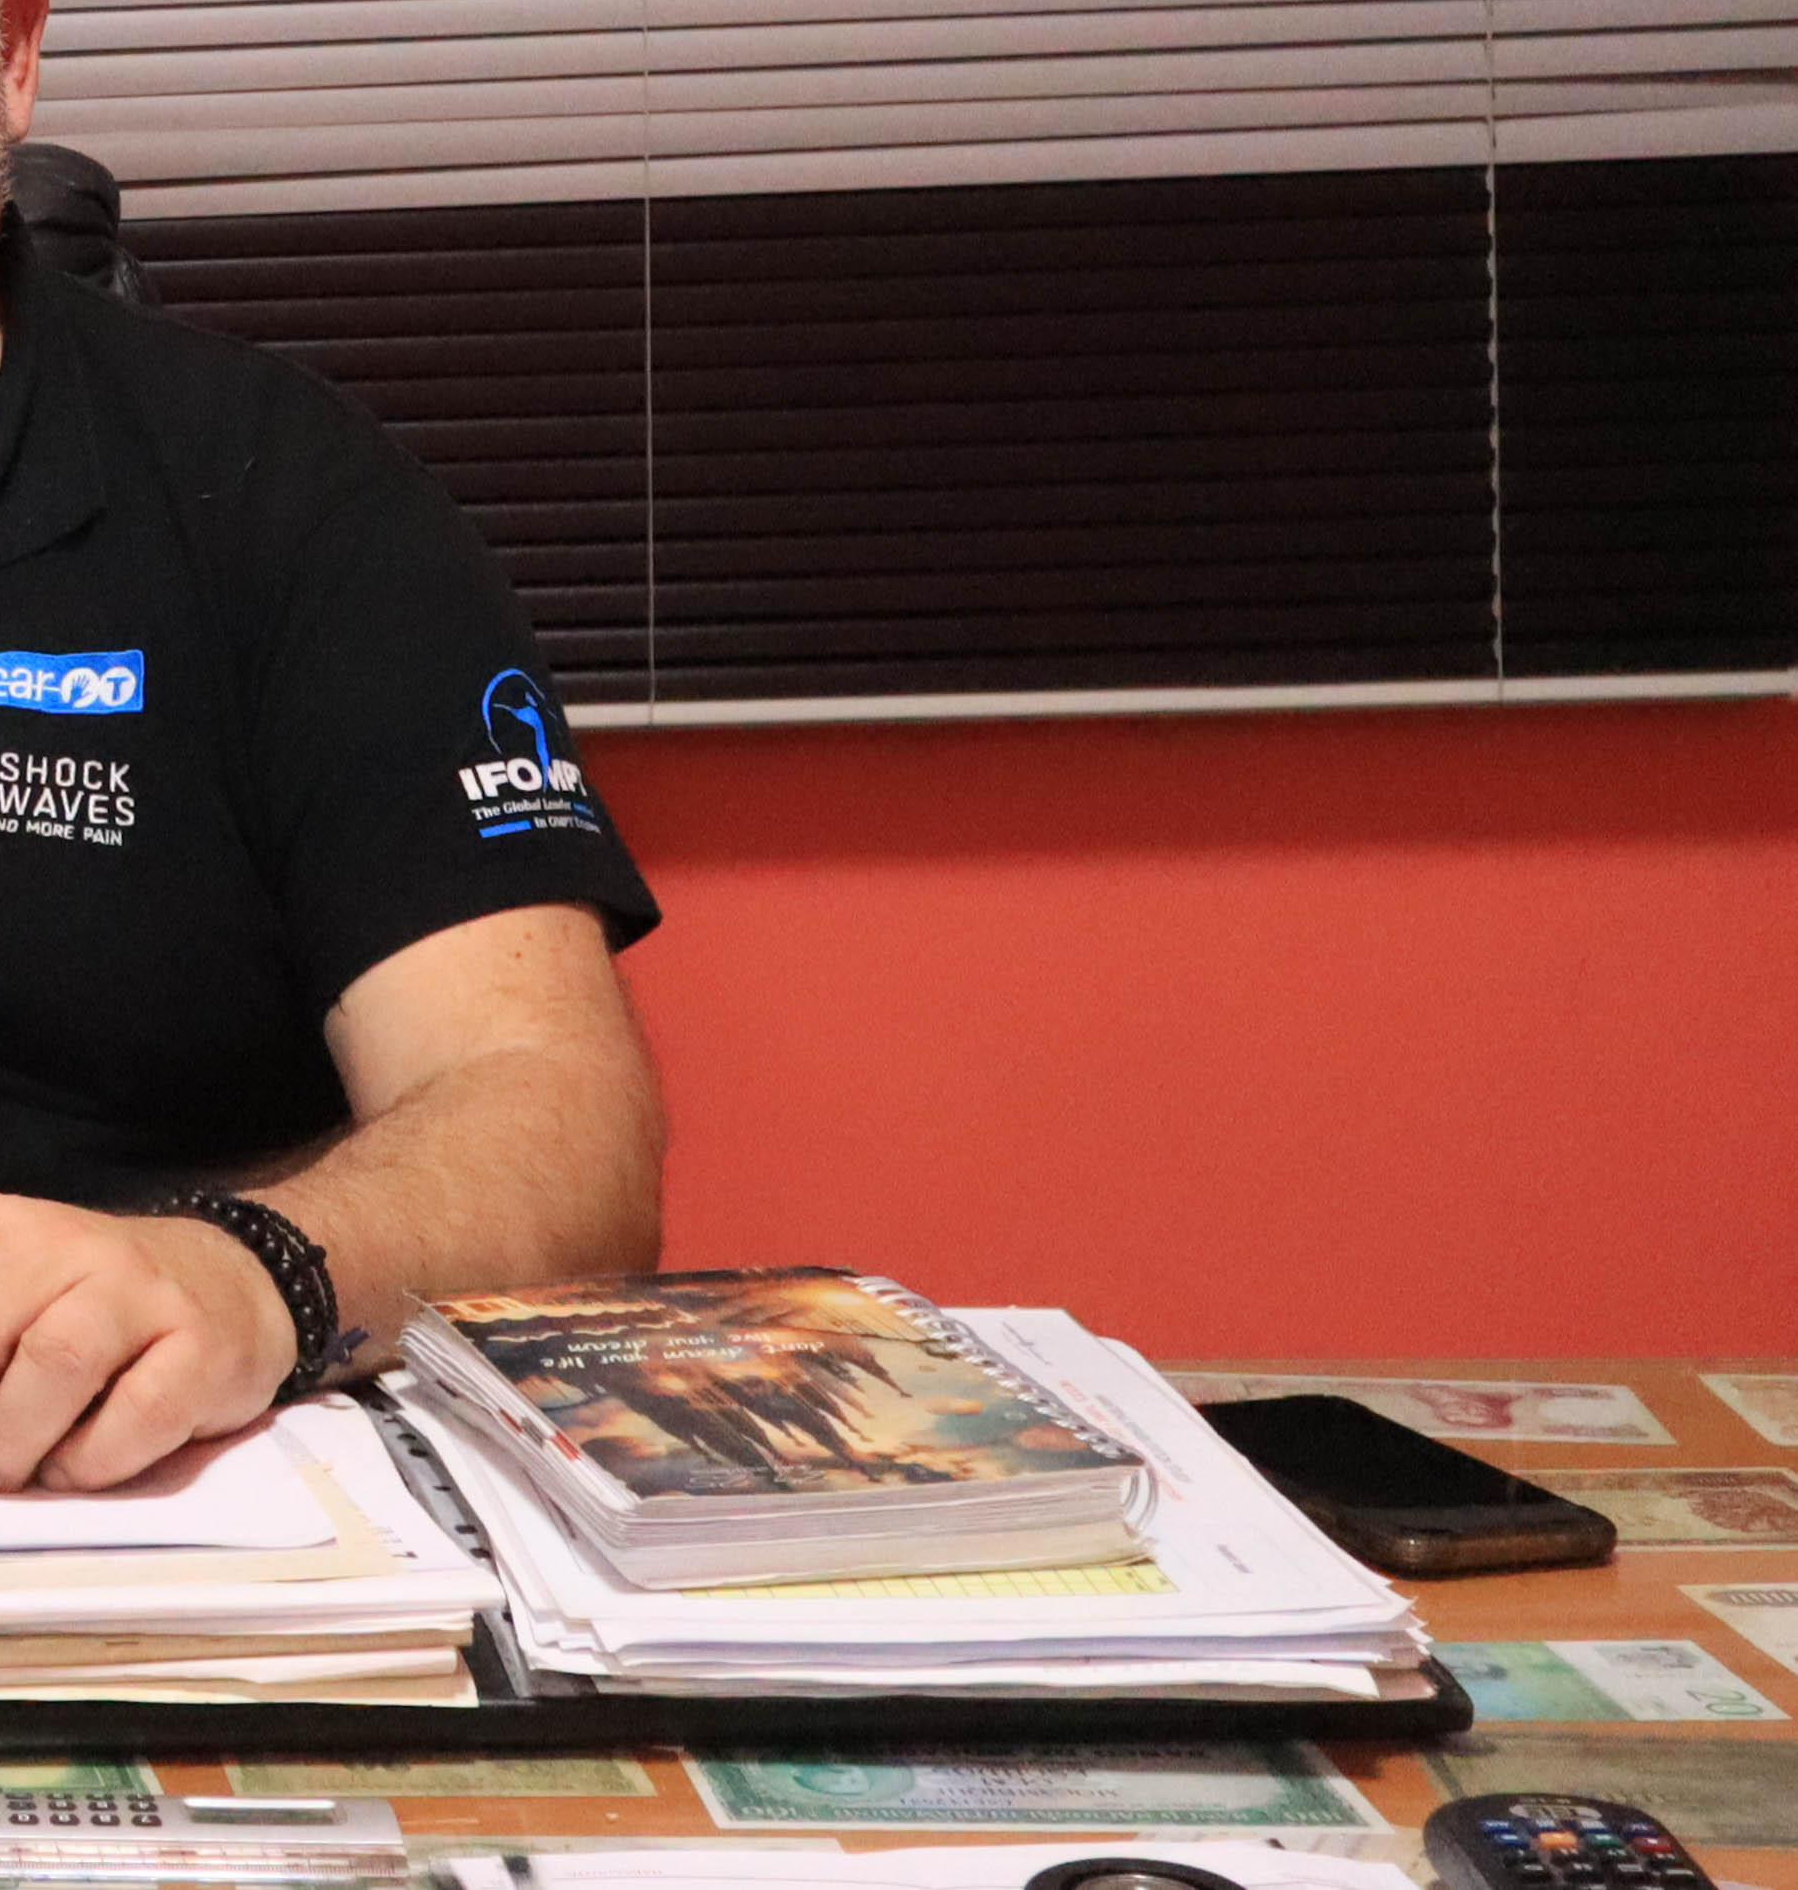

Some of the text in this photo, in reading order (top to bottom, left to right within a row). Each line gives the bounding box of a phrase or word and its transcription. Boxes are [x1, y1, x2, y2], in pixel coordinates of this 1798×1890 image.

[472, 805, 502, 821] The
[503, 798, 542, 815] Global
[25, 821, 75, 841] MORE
[83, 826, 124, 847] PAIN
[566, 1338, 649, 1353] dream
[666, 1334, 717, 1347] your
[601, 1352, 649, 1365] your
[662, 1345, 744, 1361] dream
[540, 1355, 585, 1369] life
